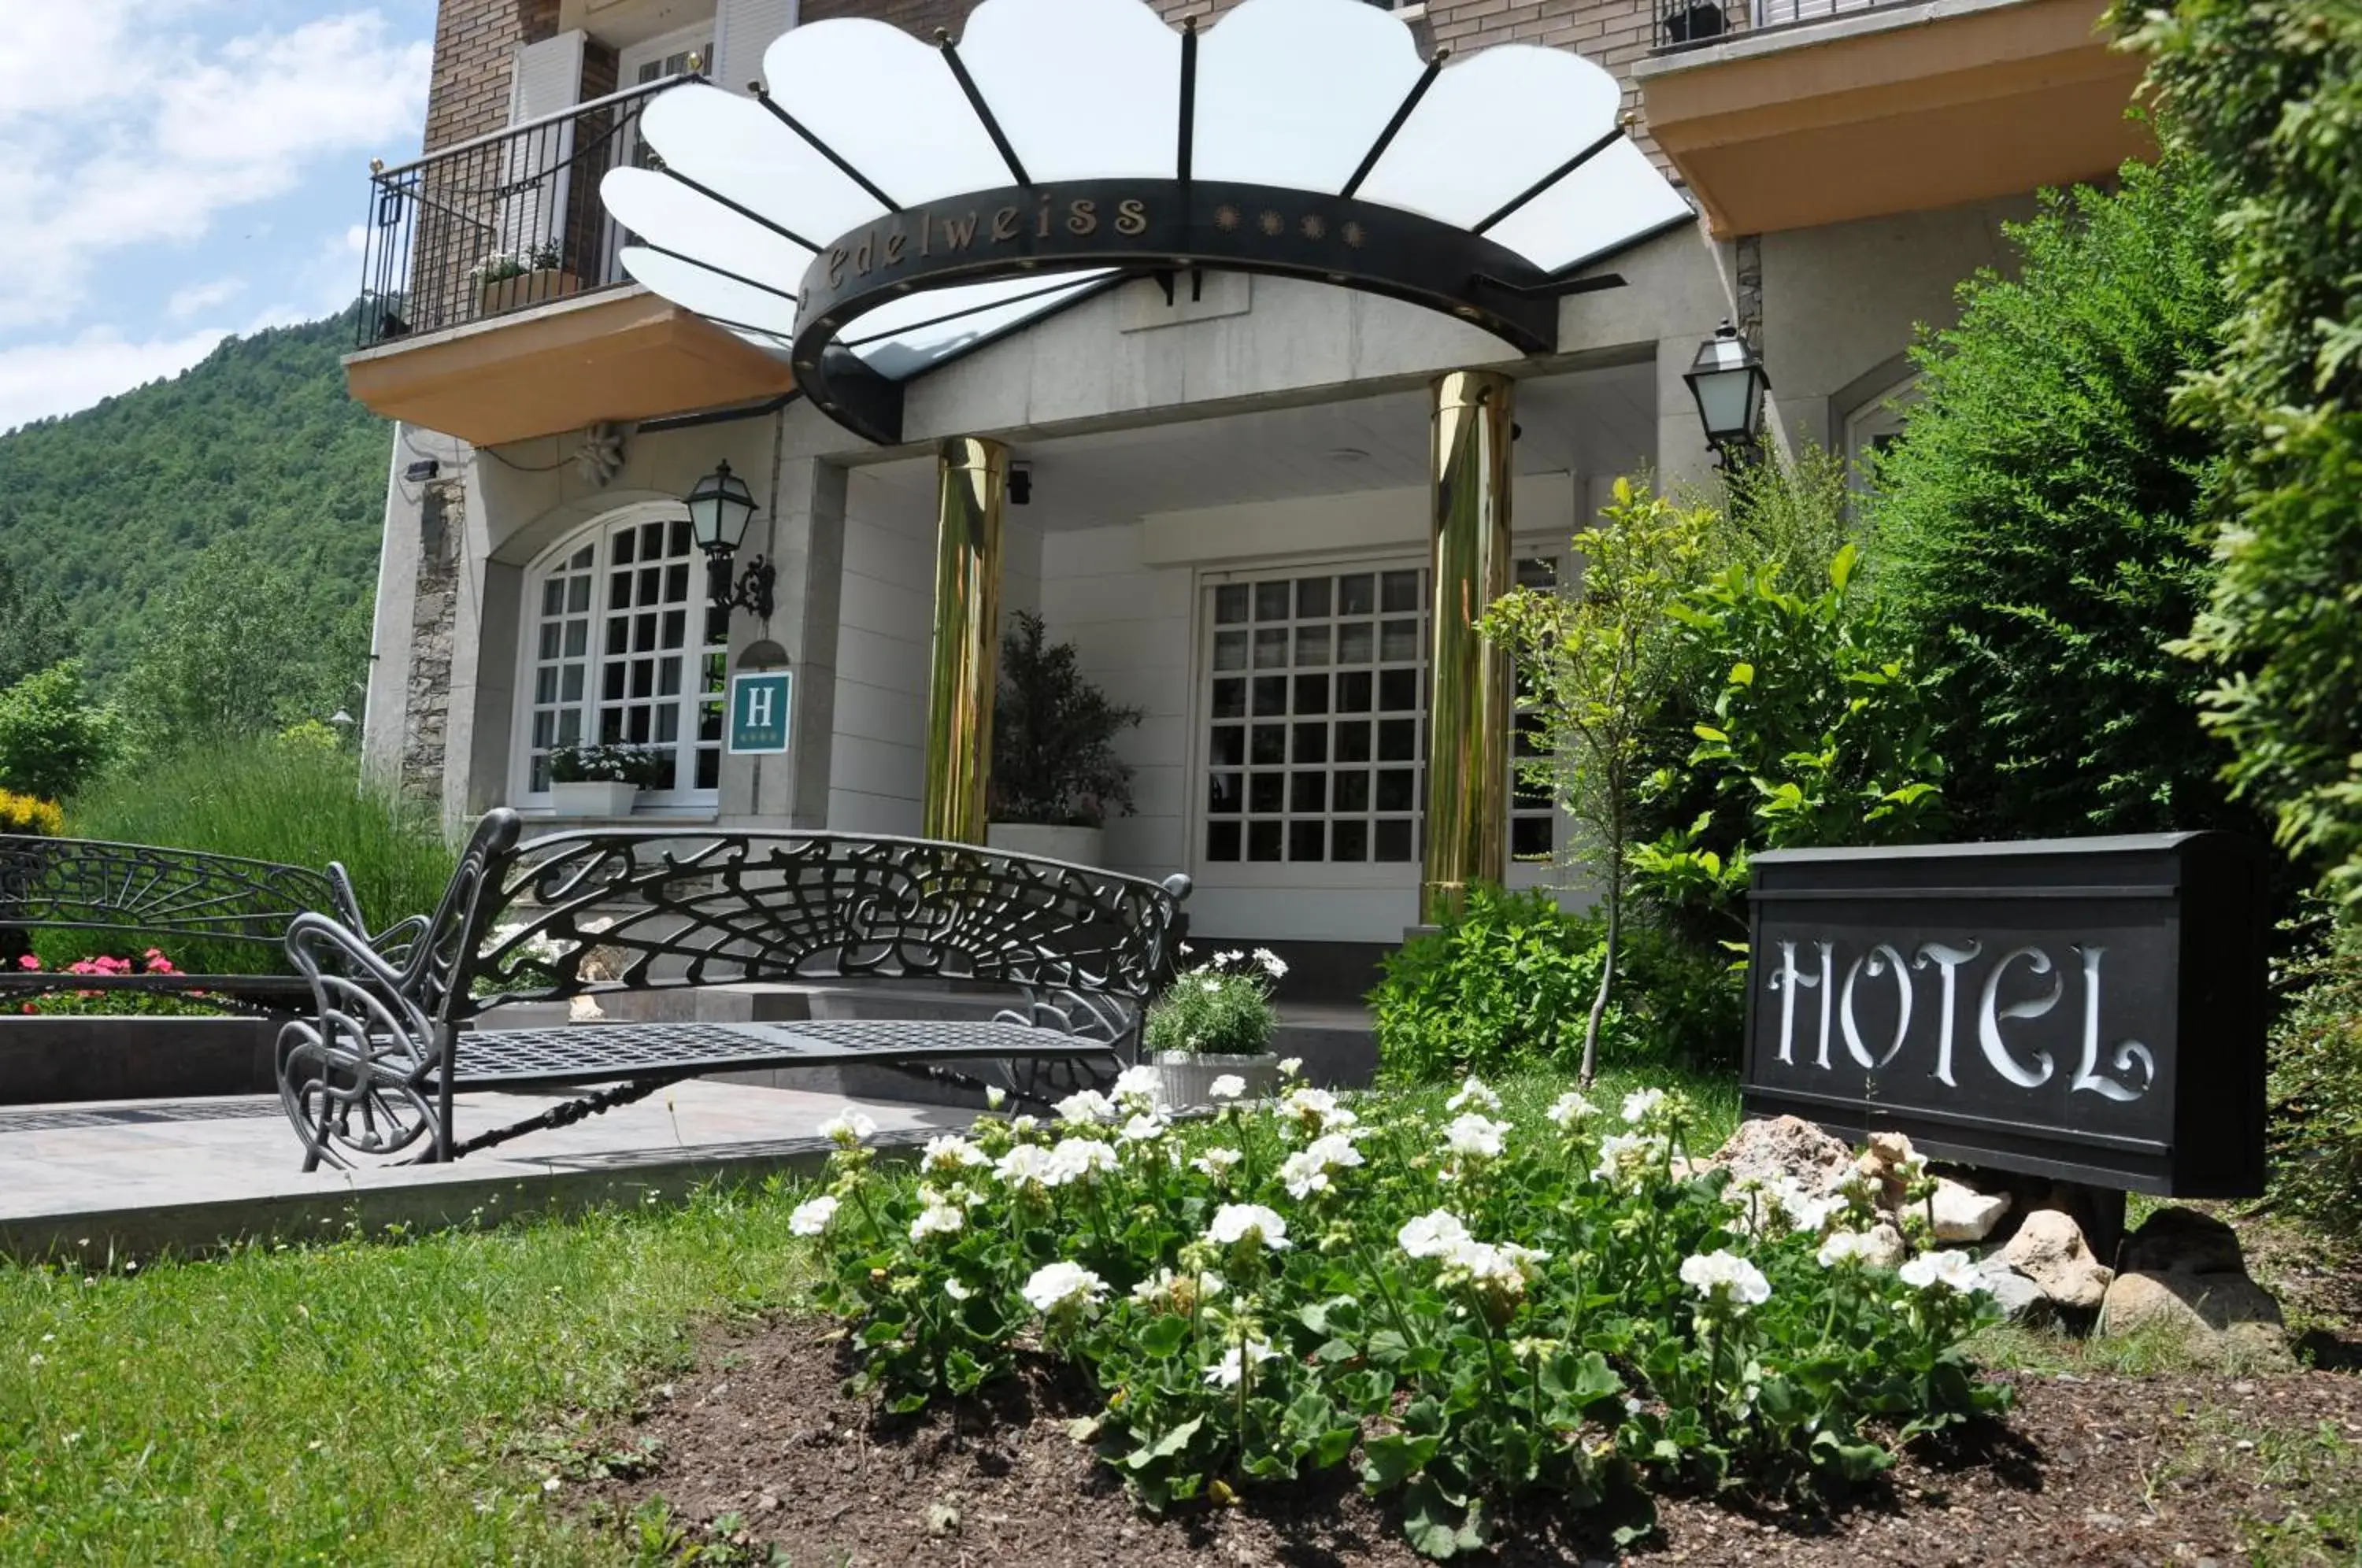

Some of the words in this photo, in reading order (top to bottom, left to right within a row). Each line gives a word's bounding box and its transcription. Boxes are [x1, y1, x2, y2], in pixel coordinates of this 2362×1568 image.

[829, 194, 1147, 290] edelweiss
[746, 687, 775, 727] H
[1768, 937, 2155, 1100] HOTEL
